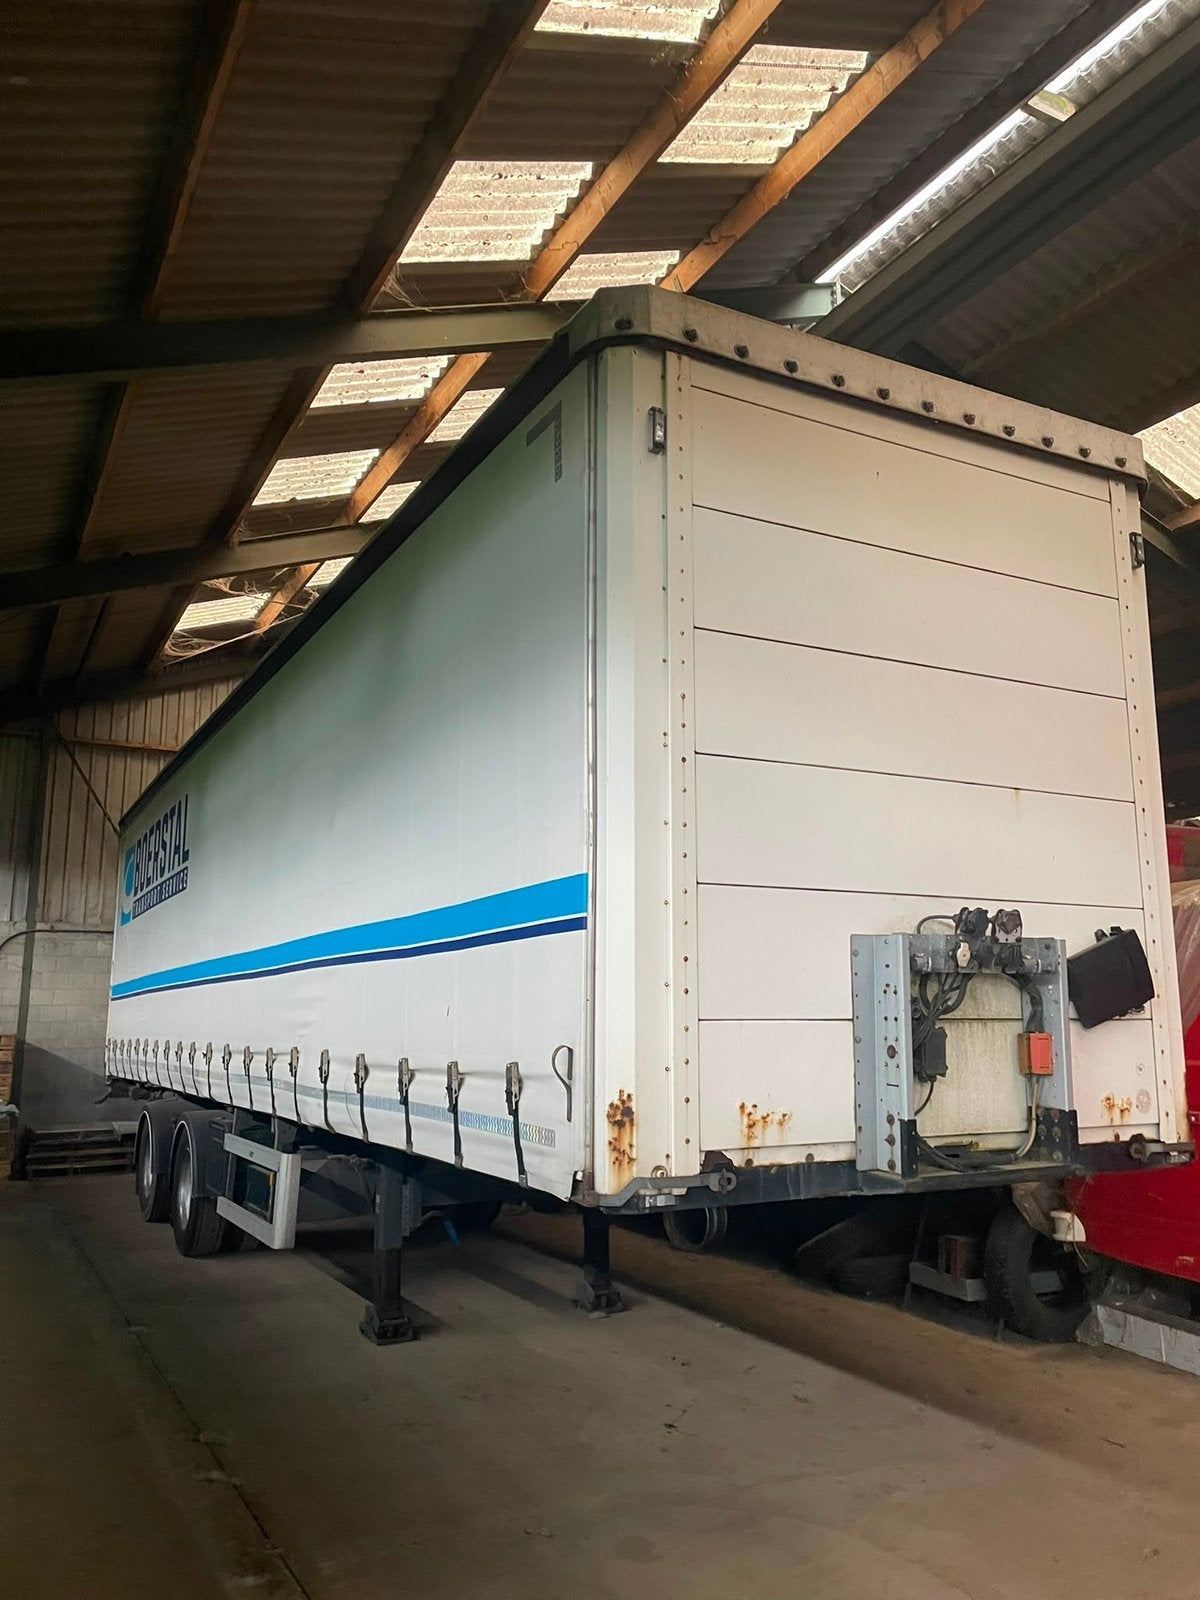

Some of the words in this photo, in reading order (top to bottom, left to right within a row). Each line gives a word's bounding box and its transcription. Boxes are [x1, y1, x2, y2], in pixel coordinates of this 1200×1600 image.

[134, 794, 190, 897] BOERSTAL
[133, 885, 160, 917] TRANSPORT
[162, 869, 187, 901] SERVICE
